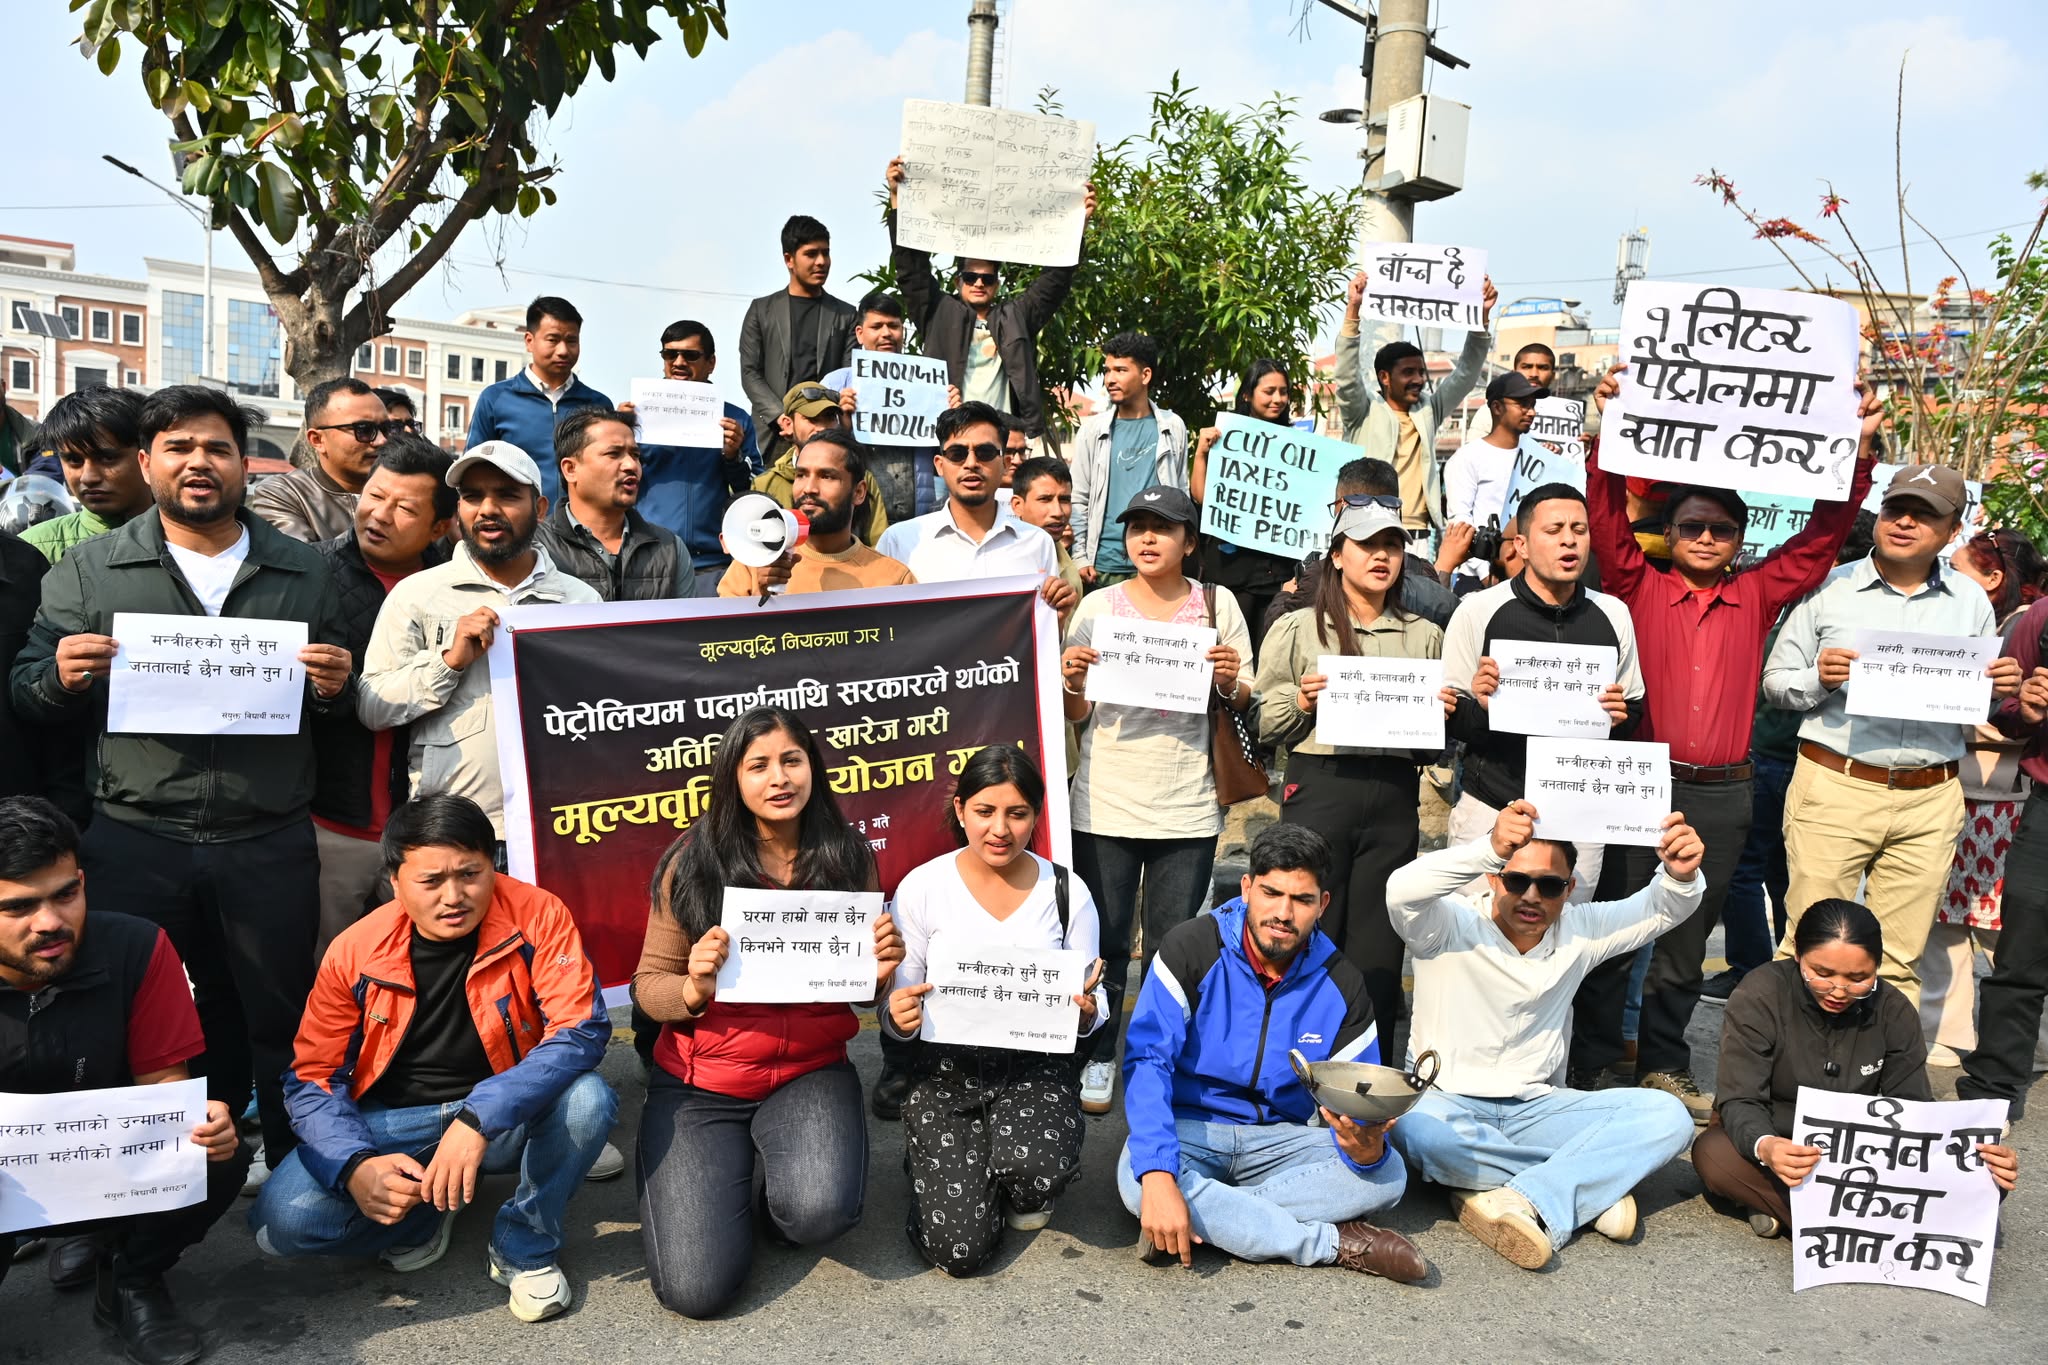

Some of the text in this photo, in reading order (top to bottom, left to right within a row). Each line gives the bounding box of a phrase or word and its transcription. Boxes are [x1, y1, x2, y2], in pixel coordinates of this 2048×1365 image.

[1369, 293, 1461, 323] सरकार
[1682, 287, 1813, 353] लिटर
[857, 358, 946, 385] ENOUGH
[1630, 335, 1835, 415] पेट्रोलमा
[881, 386, 905, 407] IS
[1620, 412, 1718, 462] सात
[1223, 429, 1319, 473] CUT OIL
[1219, 456, 1289, 491] TAXES
[1513, 447, 1545, 483] NO
[1213, 482, 1303, 523] RELIEVE
[1208, 504, 1242, 535] THE
[229, 634, 251, 654] सुनै
[257, 640, 278, 655] सुन
[699, 627, 894, 662] मूल्यवृद्धि नियन्त्रण गर !
[1192, 641, 1199, 650] र
[1971, 652, 1979, 660] र
[128, 659, 192, 676] जनतालाई
[198, 658, 223, 678] छैन
[229, 662, 256, 677] खाने
[262, 667, 282, 682] नुन
[1145, 653, 1180, 668] नियन्त्रण
[1184, 661, 1196, 670] गर
[1566, 657, 1582, 673] सुनै
[1586, 662, 1600, 675] सुन
[1912, 665, 1952, 677] नियन्त्रण
[1957, 669, 1973, 679] गर
[1420, 675, 1426, 685] र
[1498, 676, 1602, 696] जनतालाई छैन खाने नुन
[543, 698, 686, 741] पेट्रोलियम
[836, 665, 949, 706] सरकारले
[955, 655, 1020, 689] थपेको
[1413, 696, 1425, 705] गर
[826, 716, 900, 750] खारेज
[906, 706, 950, 737] गरी
[1617, 756, 1633, 775] सुनै
[1637, 761, 1652, 775] सुन
[1538, 778, 1587, 793] जनतालाई
[1592, 777, 1610, 795] छैन
[1615, 781, 1636, 795] खाने
[1640, 786, 1655, 799] नुन
[872, 813, 890, 829] गते
[742, 906, 867, 926] घरमा हाम्रो बास छैन
[740, 936, 786, 953] किनभने
[791, 941, 823, 954] ग्यास
[827, 936, 851, 956] छैन
[1019, 962, 1039, 982] सुनै
[1042, 968, 1060, 984] सुन
[939, 985, 988, 999] जनतालाई
[993, 984, 1013, 1003] छैन
[1017, 989, 1040, 1003] खाने
[1045, 993, 1062, 1008] नुन
[53, 1114, 109, 1134] सत्ताको
[116, 1110, 186, 1129] उन्मादमा
[1802, 1098, 1943, 1173] बालेन
[119, 1139, 167, 1157] मारमा
[1815, 1166, 1947, 1224] किन
[1800, 1226, 1983, 1286] सात कर
